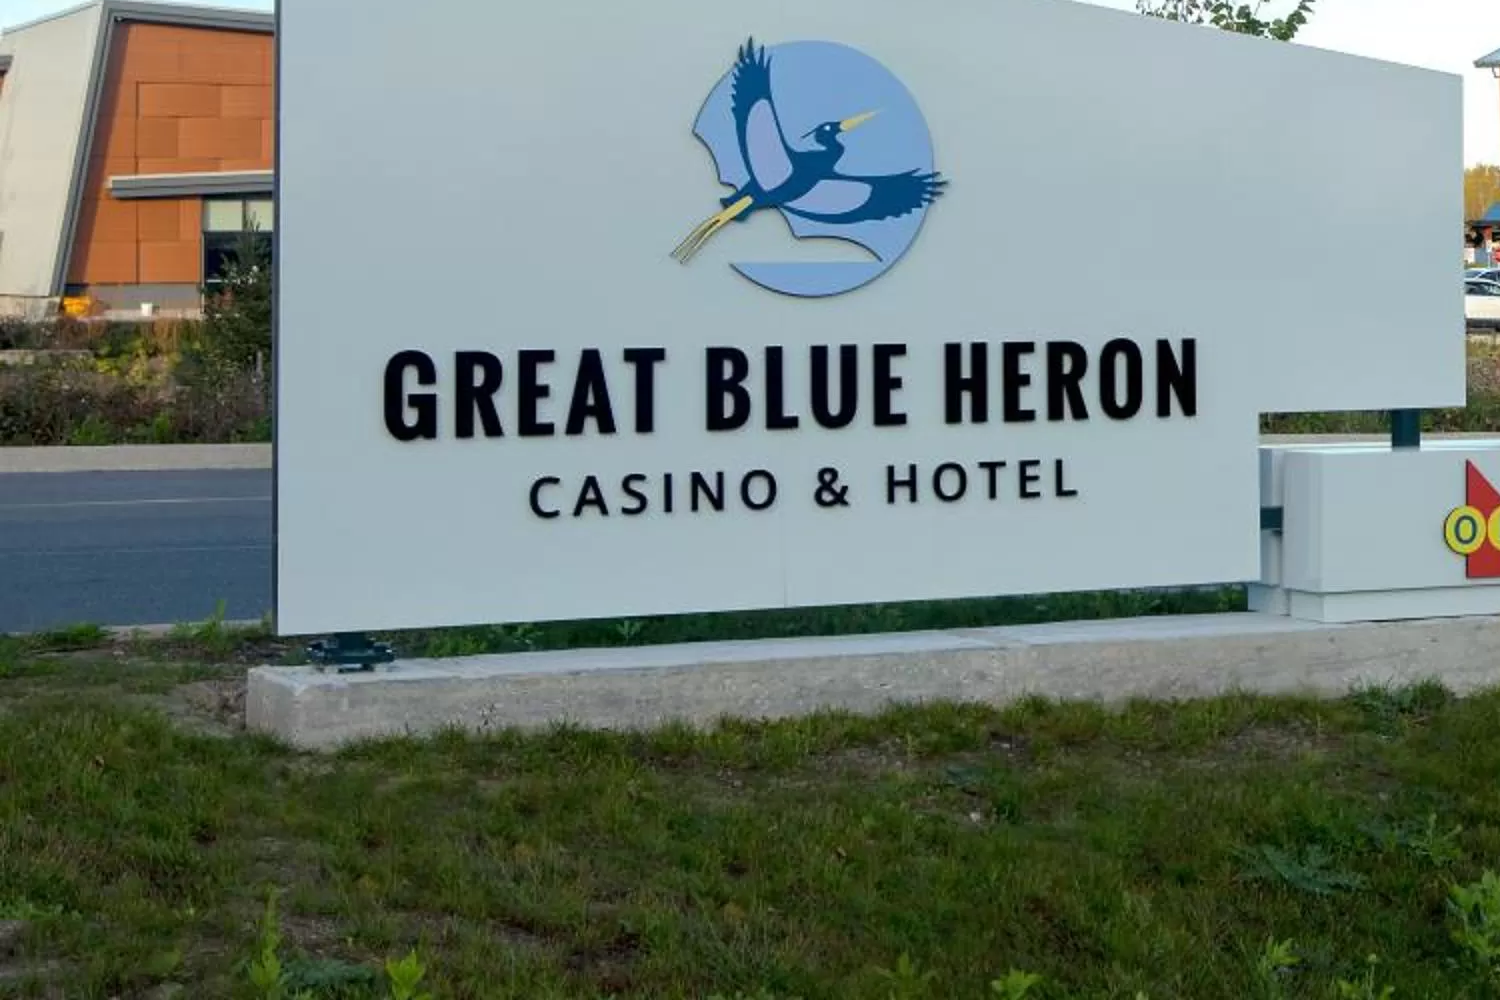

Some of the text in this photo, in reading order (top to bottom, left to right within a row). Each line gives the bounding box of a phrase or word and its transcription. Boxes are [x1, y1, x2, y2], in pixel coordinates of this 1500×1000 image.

[382, 337, 1198, 443] GREAT BLUE HERON
[528, 458, 1079, 520] CASINO & HOTEL
